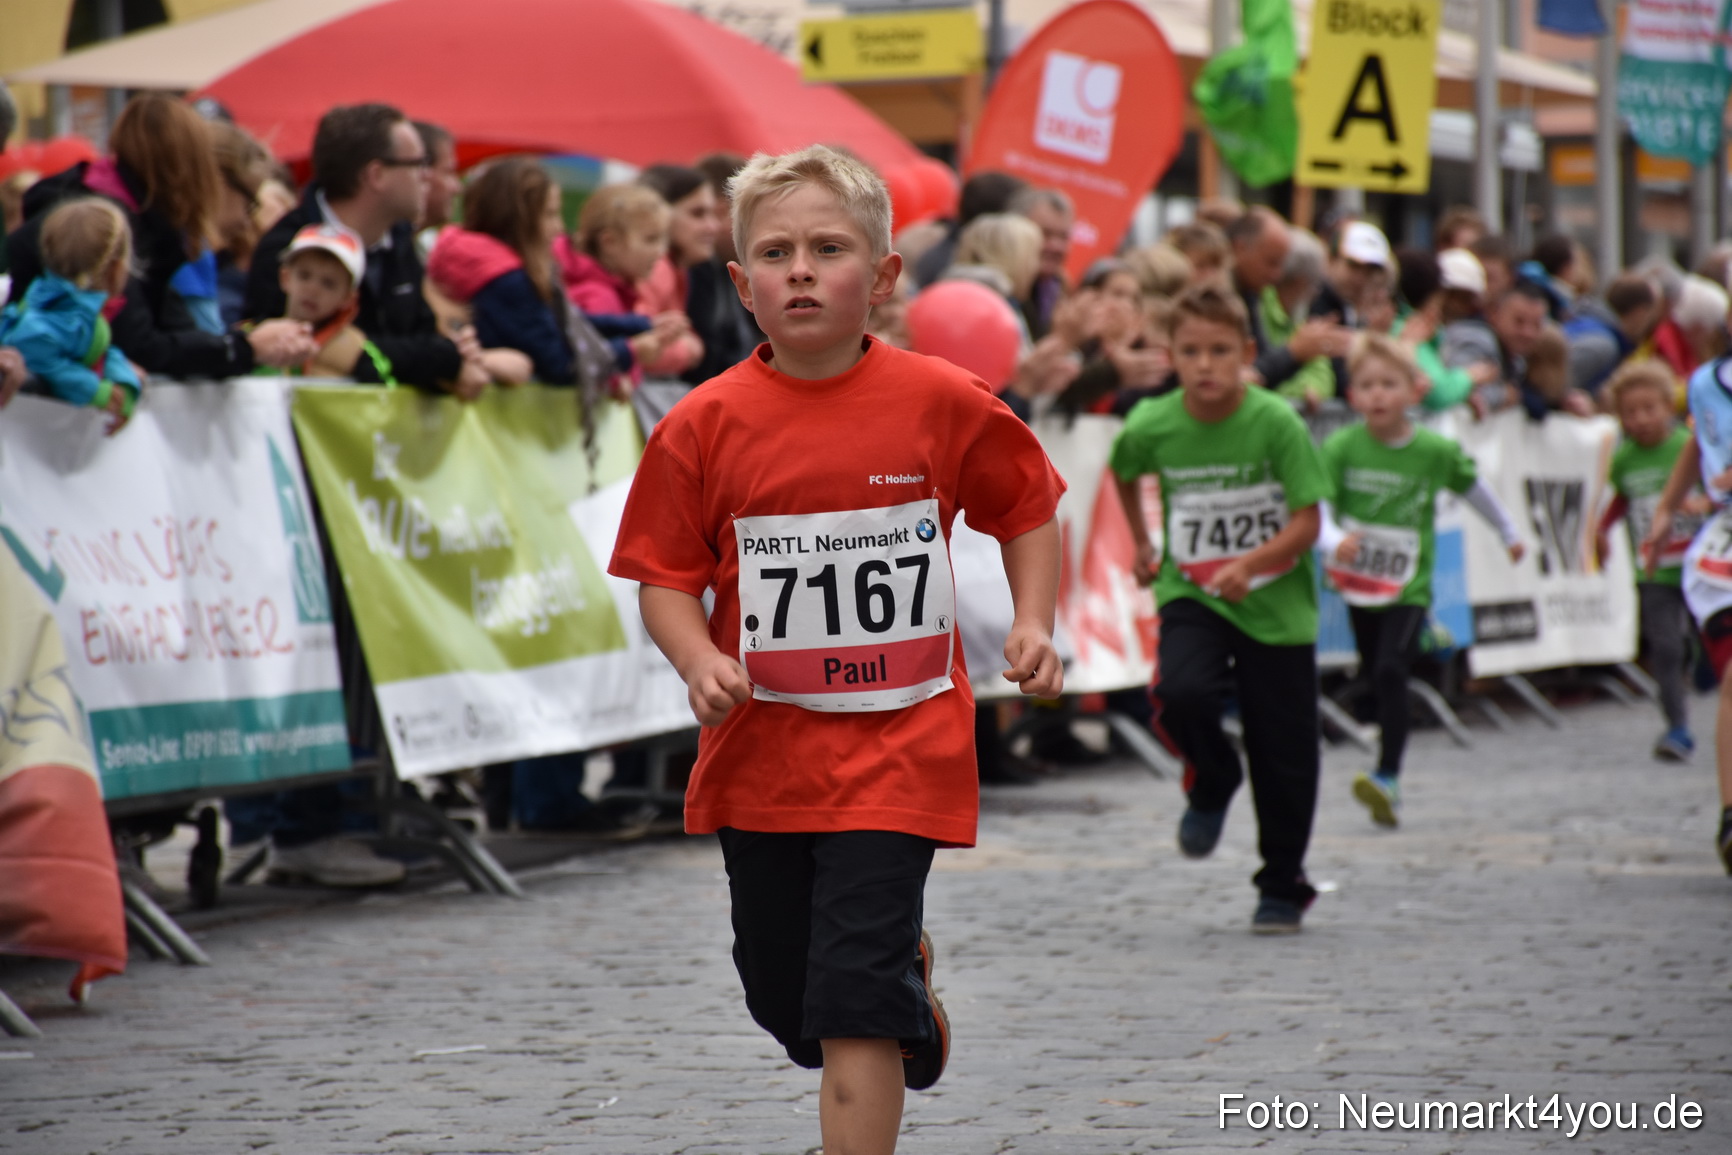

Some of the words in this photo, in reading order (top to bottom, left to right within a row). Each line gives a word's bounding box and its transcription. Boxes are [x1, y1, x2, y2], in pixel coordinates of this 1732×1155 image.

[1328, 0, 1428, 38] Block
[1331, 53, 1399, 145] A
[869, 474, 883, 485] FC
[743, 536, 810, 555] PARTL
[815, 527, 910, 552] Neumarkt
[1181, 509, 1281, 556] 7425
[760, 553, 930, 639] 7167
[938, 617, 946, 630] K
[750, 636, 757, 649] 4
[824, 654, 887, 685] Paul
